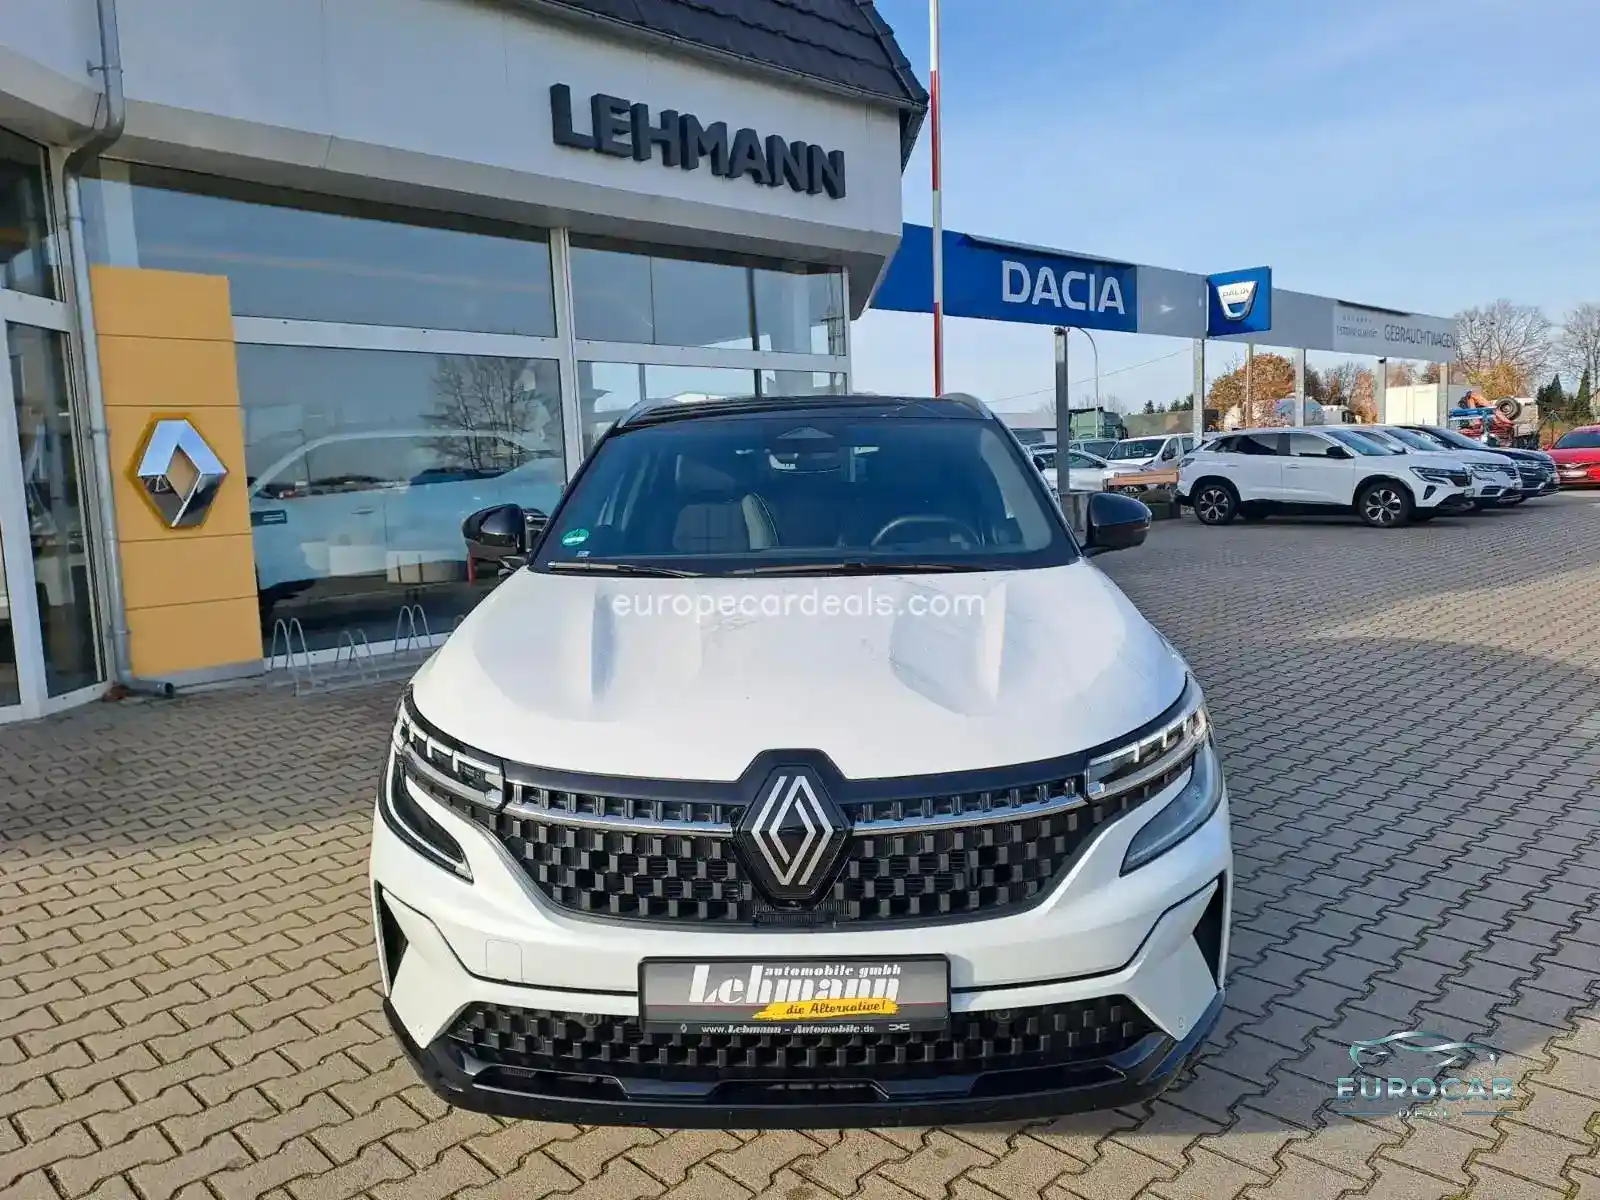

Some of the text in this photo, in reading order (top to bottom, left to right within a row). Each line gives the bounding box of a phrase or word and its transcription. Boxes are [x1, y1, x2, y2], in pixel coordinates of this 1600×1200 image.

[550, 83, 846, 199] LEHMANN
[1002, 260, 1125, 315] DACIA
[1384, 323, 1456, 349] GEBRAUCHTWAGEN
[689, 964, 901, 1004] Lehmann
[764, 964, 901, 978] automobile gmbh
[786, 1002, 886, 1015] die Alternative!
